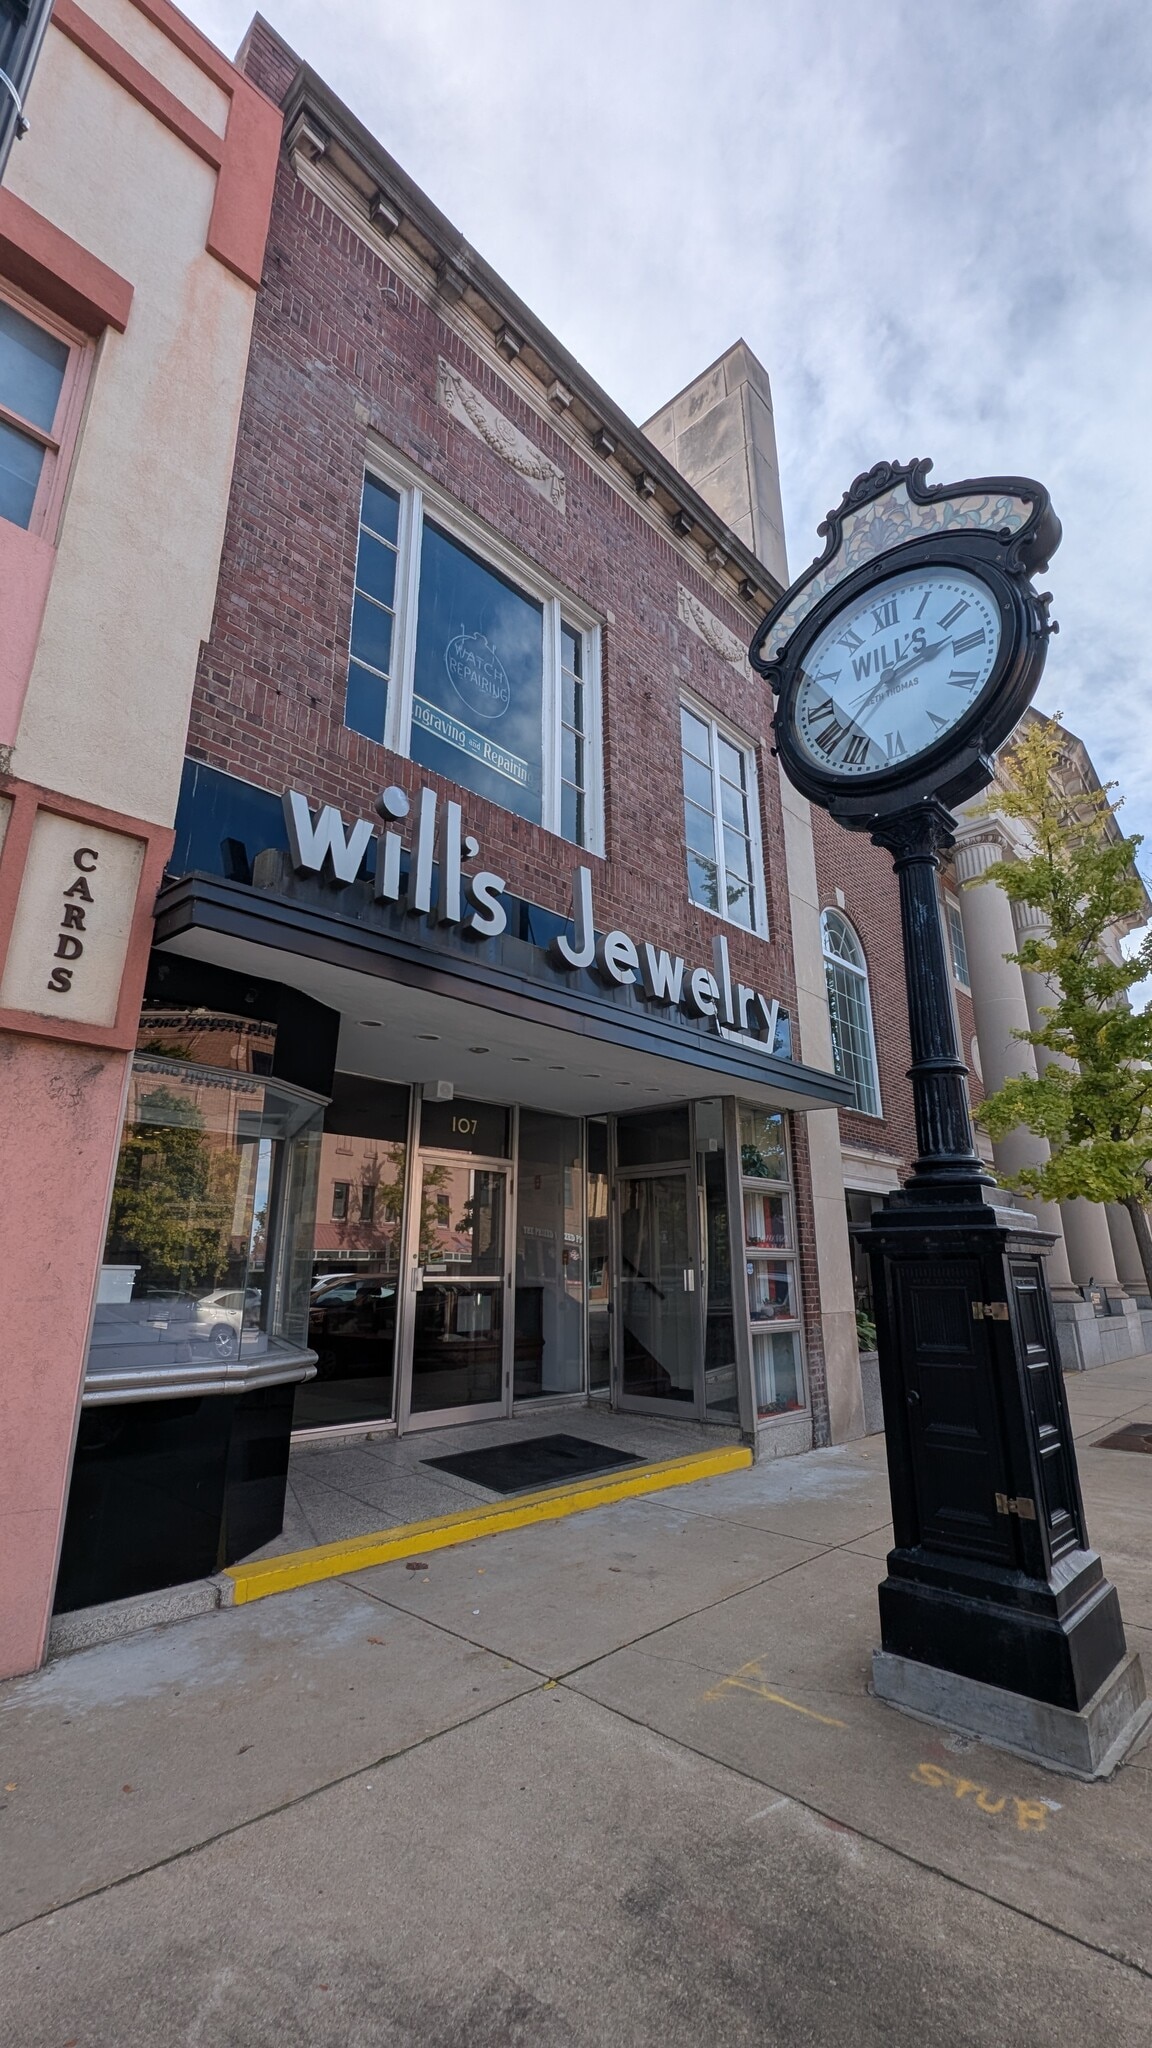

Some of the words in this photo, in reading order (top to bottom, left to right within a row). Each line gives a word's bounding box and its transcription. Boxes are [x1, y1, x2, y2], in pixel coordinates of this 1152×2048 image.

[871, 599, 900, 636] XII
[455, 643, 504, 683] WATCH
[852, 627, 927, 682] WILL'S
[450, 658, 508, 701] REPAIRING
[885, 676, 919, 697] THOMAS
[412, 702, 466, 747] ngraving
[468, 739, 481, 751] and
[48, 847, 98, 993] CARDS
[548, 866, 779, 1054] Jewelry
[452, 1116, 478, 1135] 107
